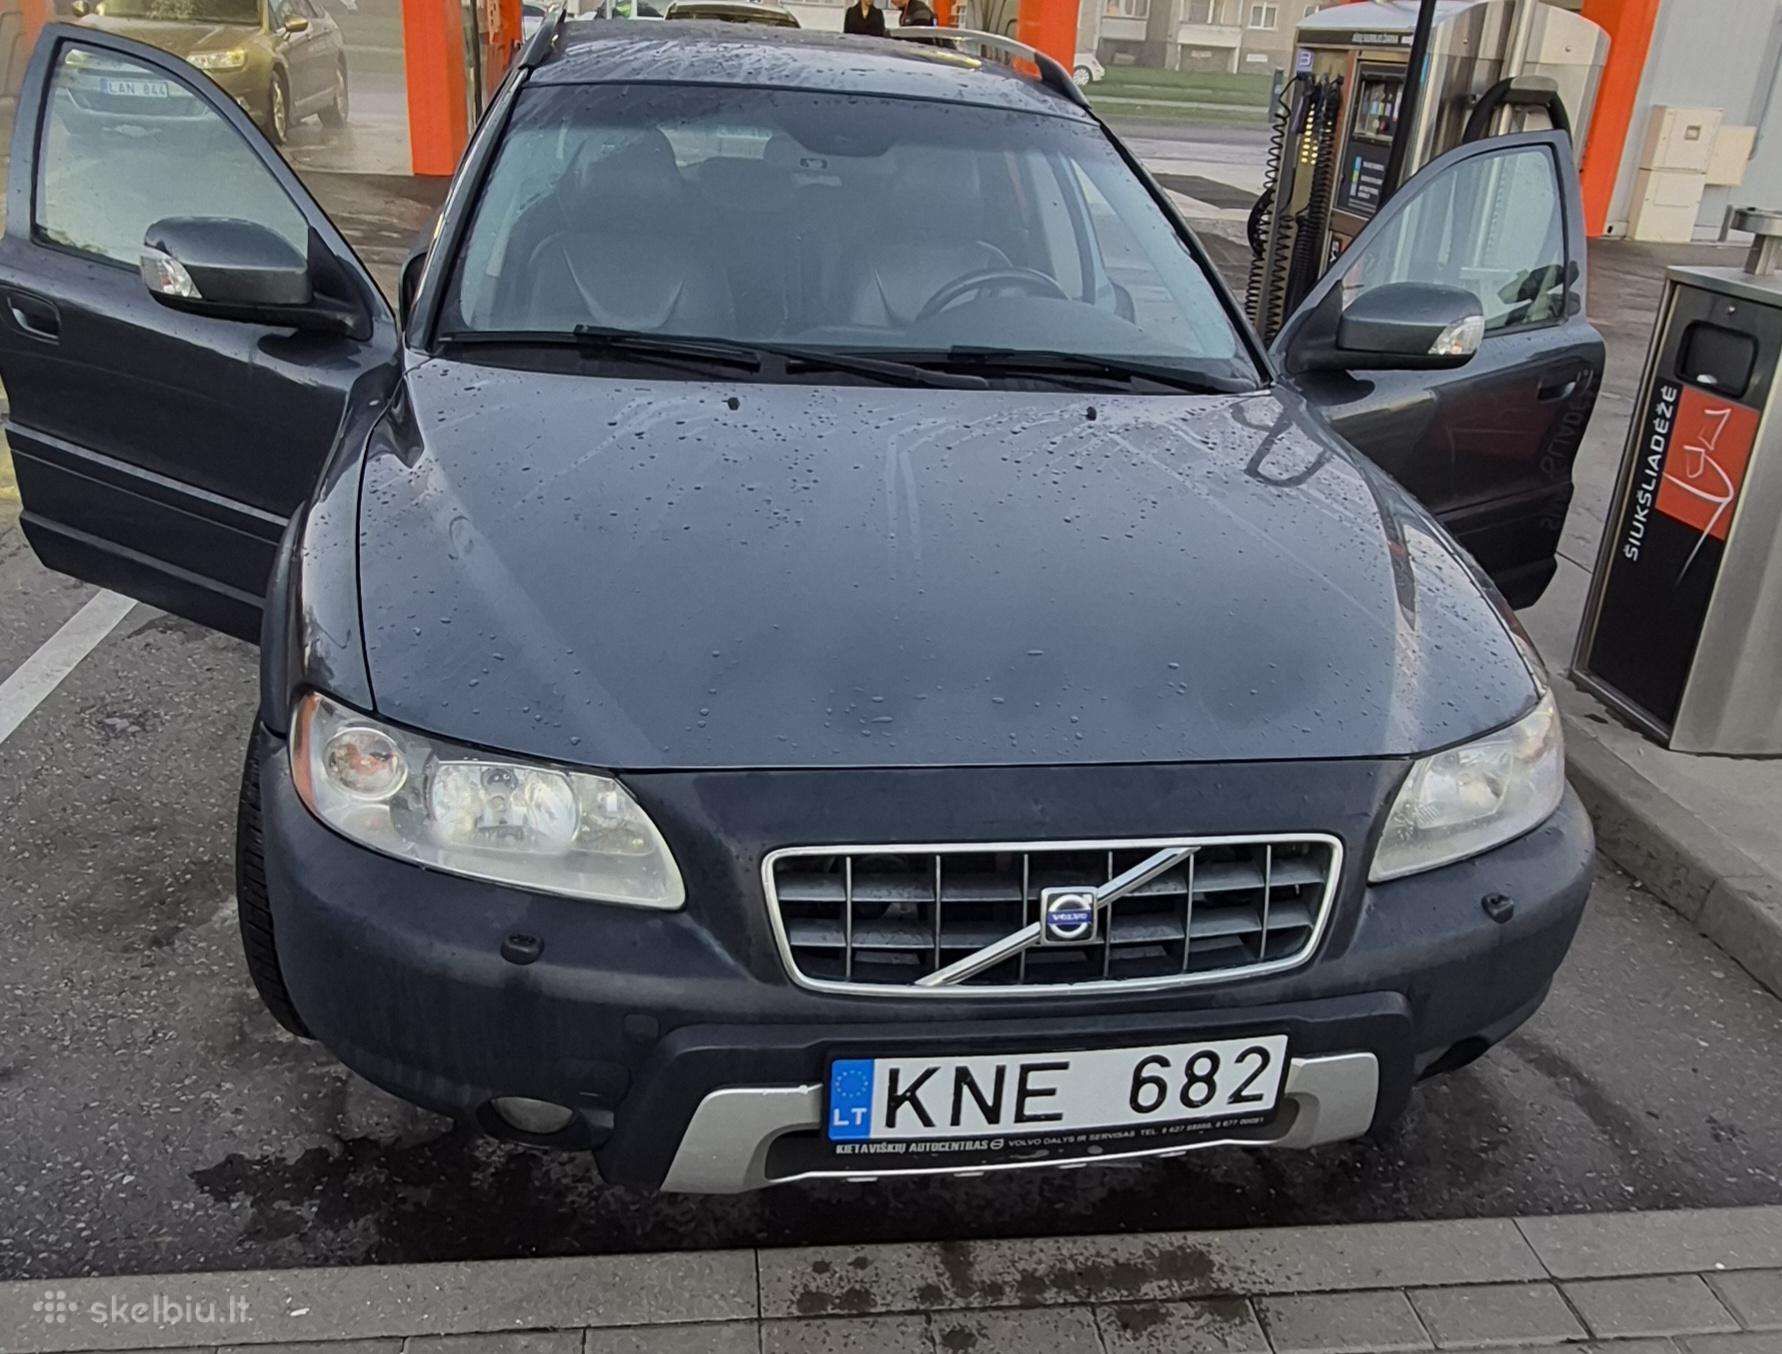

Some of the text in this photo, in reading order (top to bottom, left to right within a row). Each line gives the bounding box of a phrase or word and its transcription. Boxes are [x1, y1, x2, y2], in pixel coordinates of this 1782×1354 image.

[1624, 385, 1679, 563] ŠIUKŠLIADĖŽĖ
[1052, 912, 1087, 921] VOLVO
[884, 1045, 1272, 1129] KNE 682
[833, 1108, 867, 1126] LT
[1008, 1138, 1042, 1147] VOLVO
[1043, 1136, 1075, 1145] DALYS
[1089, 1130, 1135, 1141] SERVISAS
